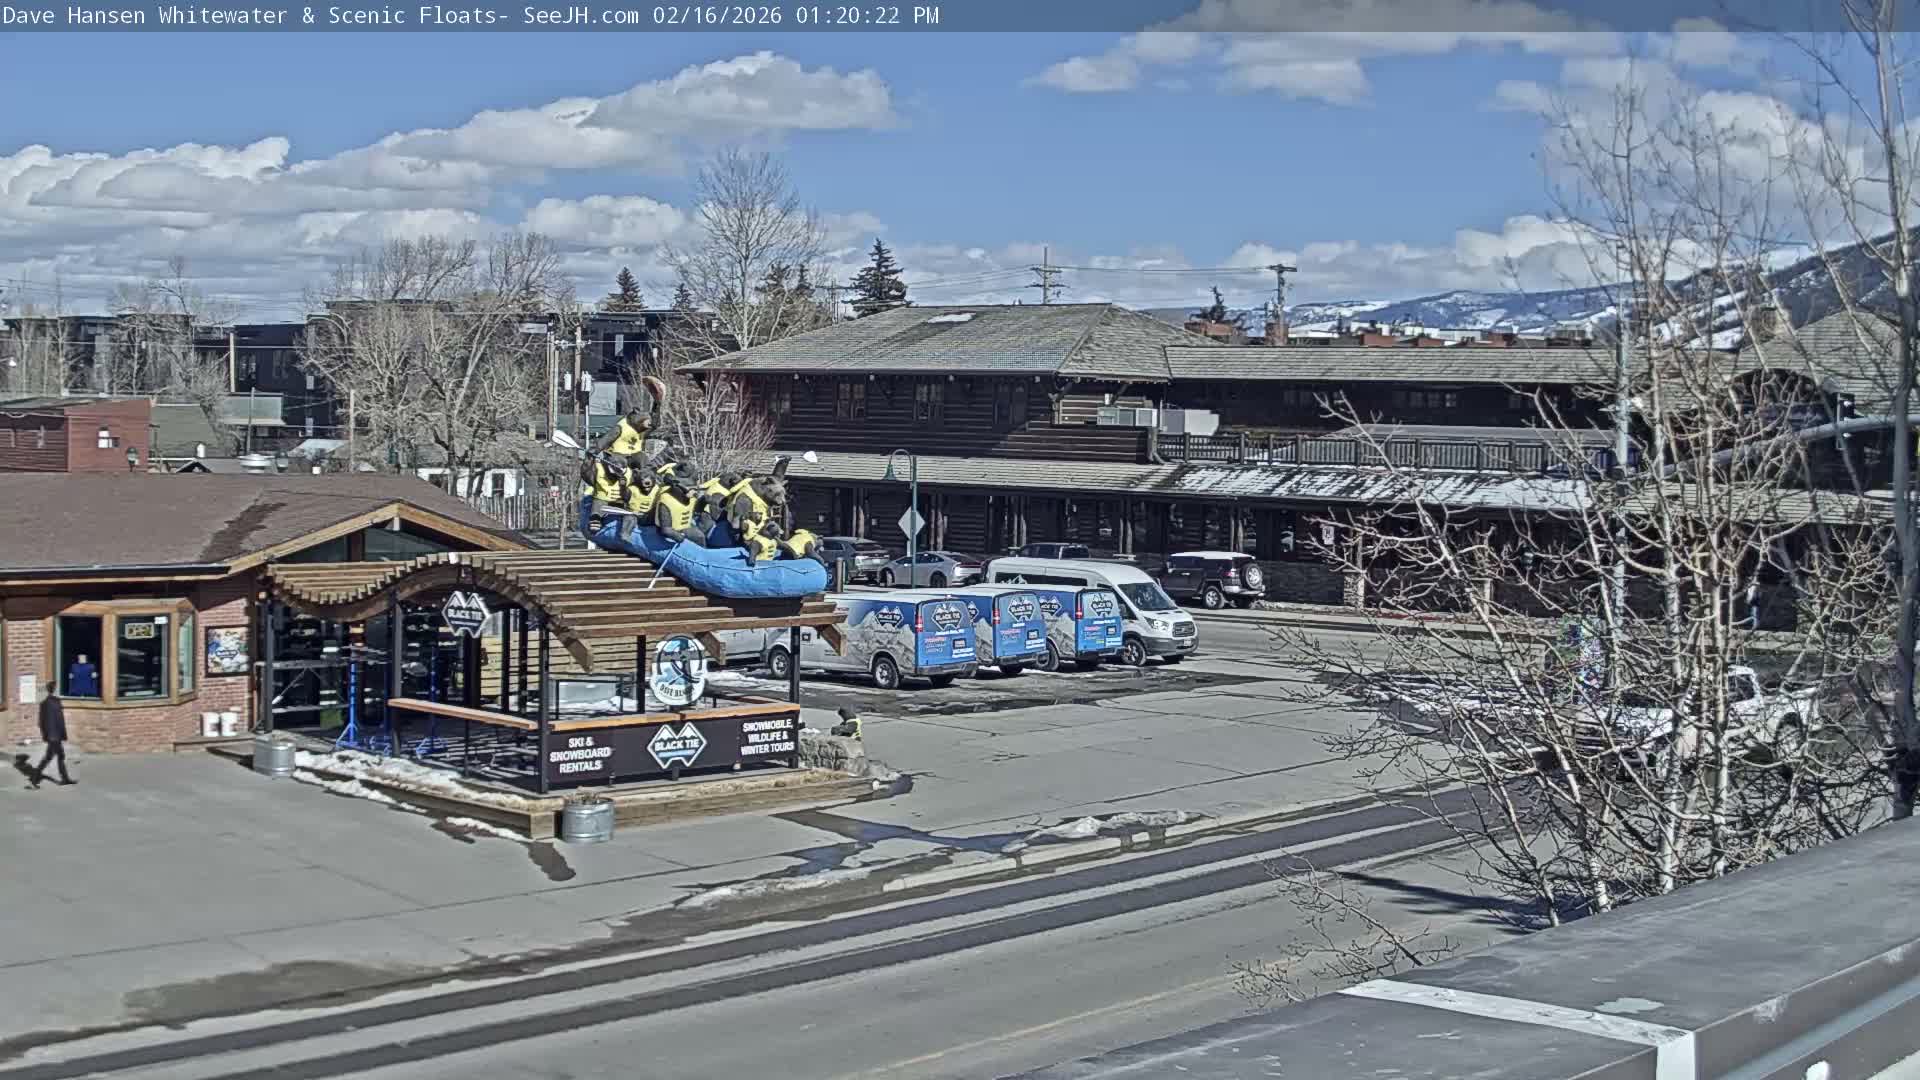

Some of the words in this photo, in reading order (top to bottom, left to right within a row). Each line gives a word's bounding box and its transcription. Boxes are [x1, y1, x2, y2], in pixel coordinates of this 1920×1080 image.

[742, 719, 793, 732] SNOWMOBILE,
[568, 737, 584, 748] SKI
[585, 736, 595, 746] &
[748, 731, 781, 743] WILDLIFE
[782, 730, 788, 740] &
[655, 740, 684, 752] BLACK
[684, 739, 700, 748] TIE
[741, 744, 770, 756] WINTER
[770, 741, 795, 752] TOURS
[549, 746, 612, 762] SNOWBOARD
[559, 760, 603, 774] RENTALS
